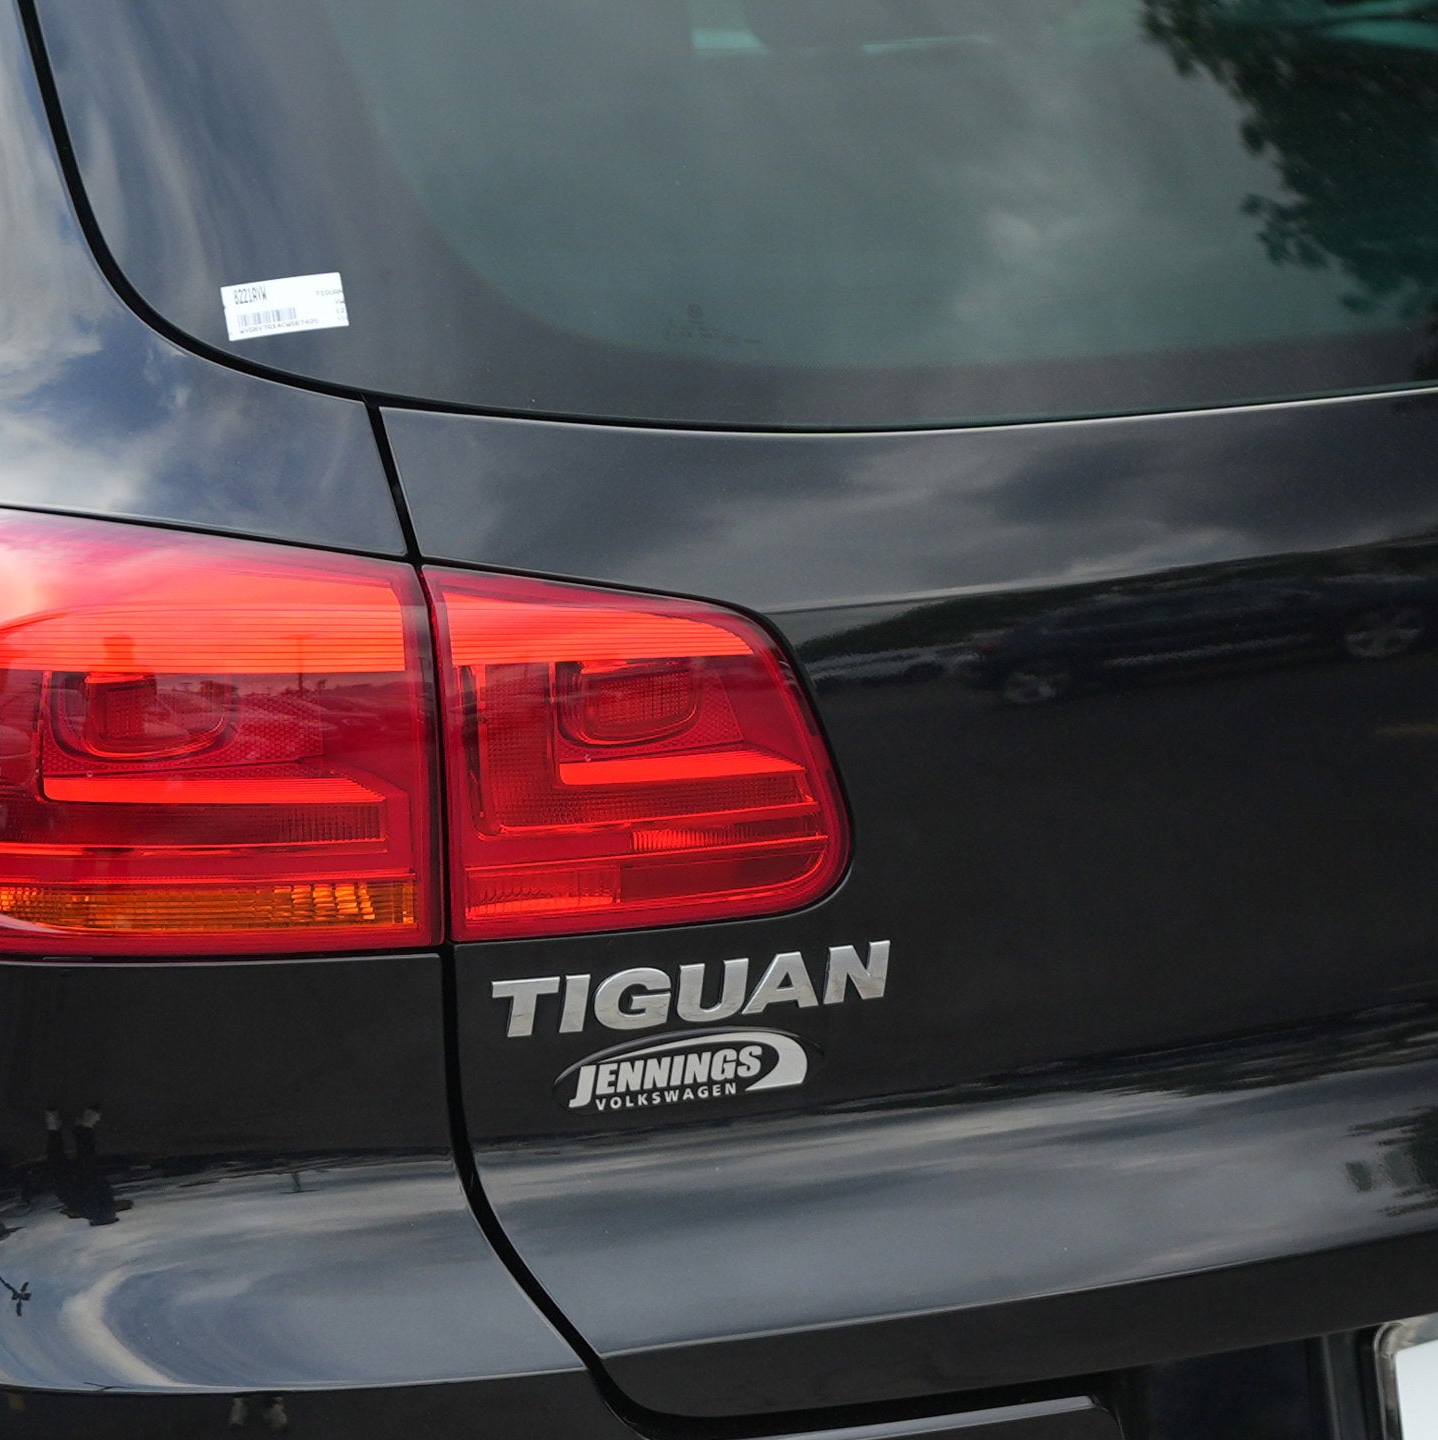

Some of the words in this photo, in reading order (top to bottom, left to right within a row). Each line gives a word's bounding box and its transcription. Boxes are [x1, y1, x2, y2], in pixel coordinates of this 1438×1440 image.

[490, 939, 892, 1039] TIGUAN
[568, 1043, 763, 1110] JENNINGS
[595, 1082, 738, 1111] VOLKSWAGEN
